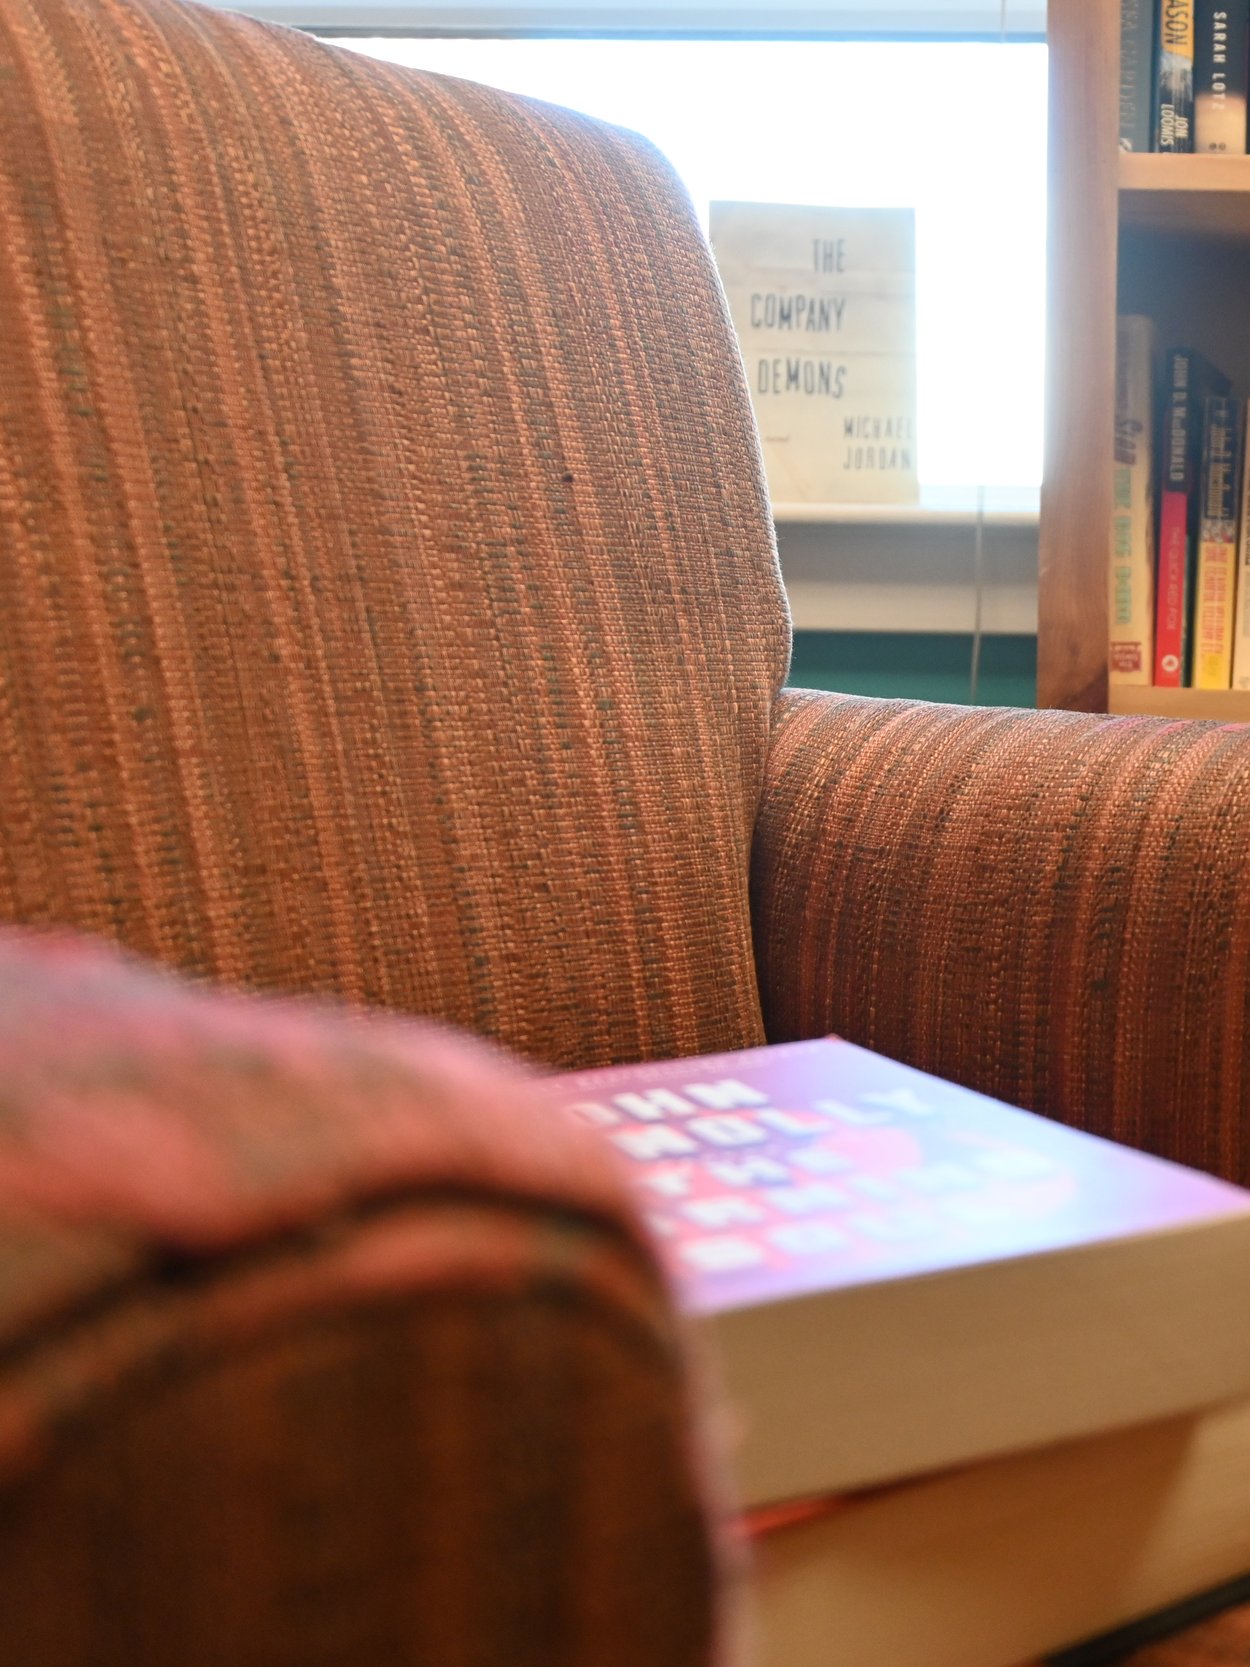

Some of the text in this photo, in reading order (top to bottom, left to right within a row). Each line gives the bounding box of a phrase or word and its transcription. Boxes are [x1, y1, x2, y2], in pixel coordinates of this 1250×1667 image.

[1212, 12, 1227, 111] SARAH LOTZ
[1160, 104, 1174, 146] LOOMIS
[1175, 115, 1188, 138] JON
[812, 238, 846, 274] THE
[750, 292, 847, 333] COMPANY
[757, 356, 848, 400] DEMONS
[1172, 353, 1190, 387] JOHN
[843, 415, 913, 441] MICHAEL
[842, 446, 912, 470] JORDAN
